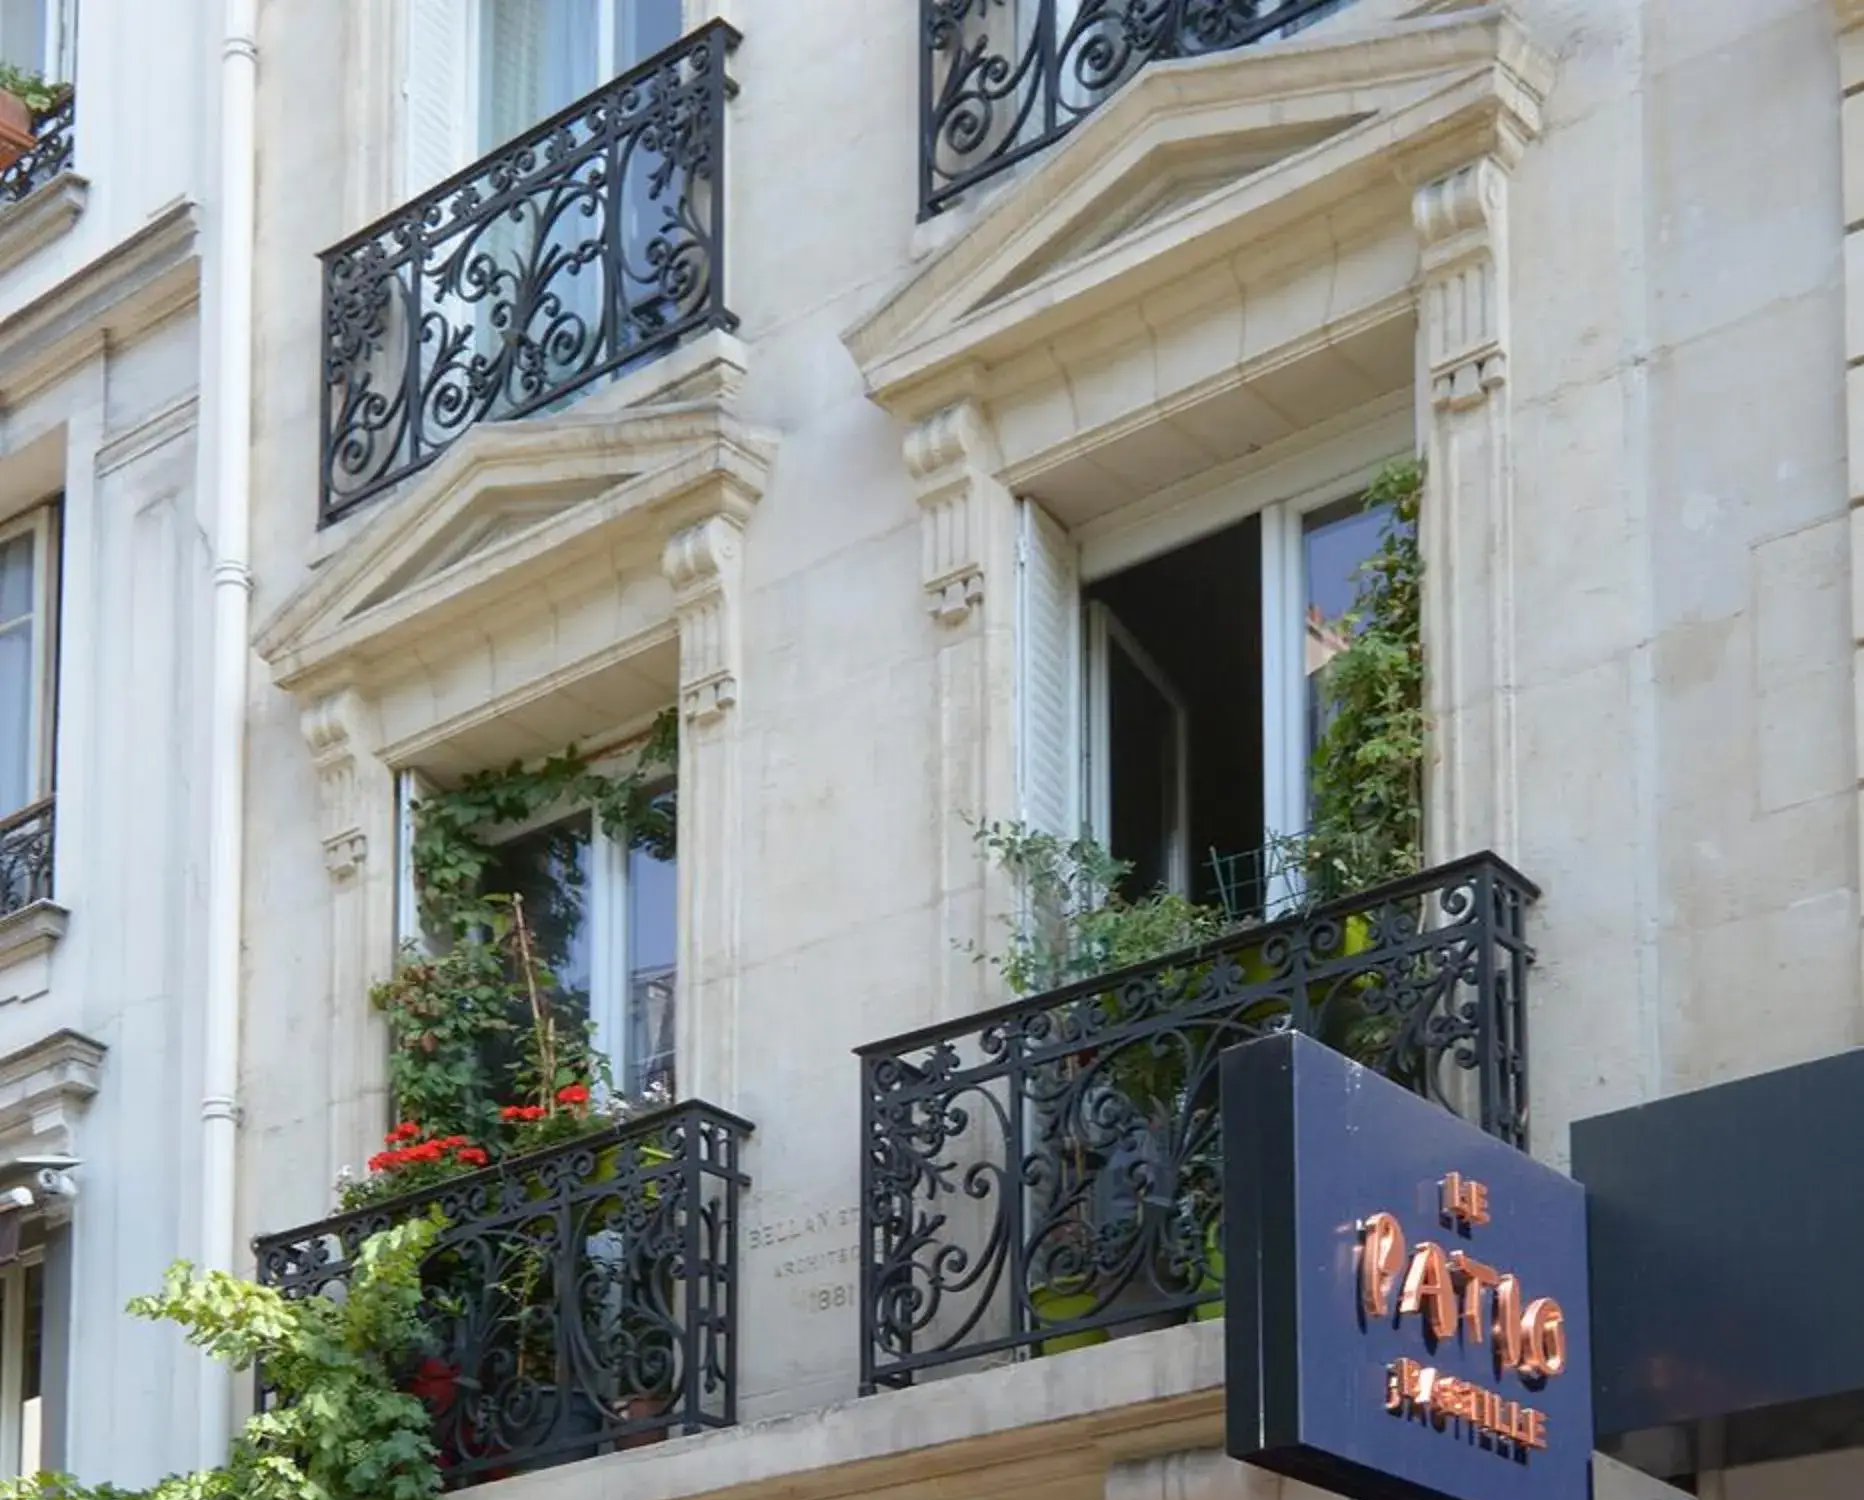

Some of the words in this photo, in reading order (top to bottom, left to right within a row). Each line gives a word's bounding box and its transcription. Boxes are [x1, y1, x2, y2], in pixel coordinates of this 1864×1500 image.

[1437, 1170, 1490, 1226] LE
[1353, 1211, 1566, 1376] PATIO
[1385, 1356, 1547, 1450] BASTILLE
